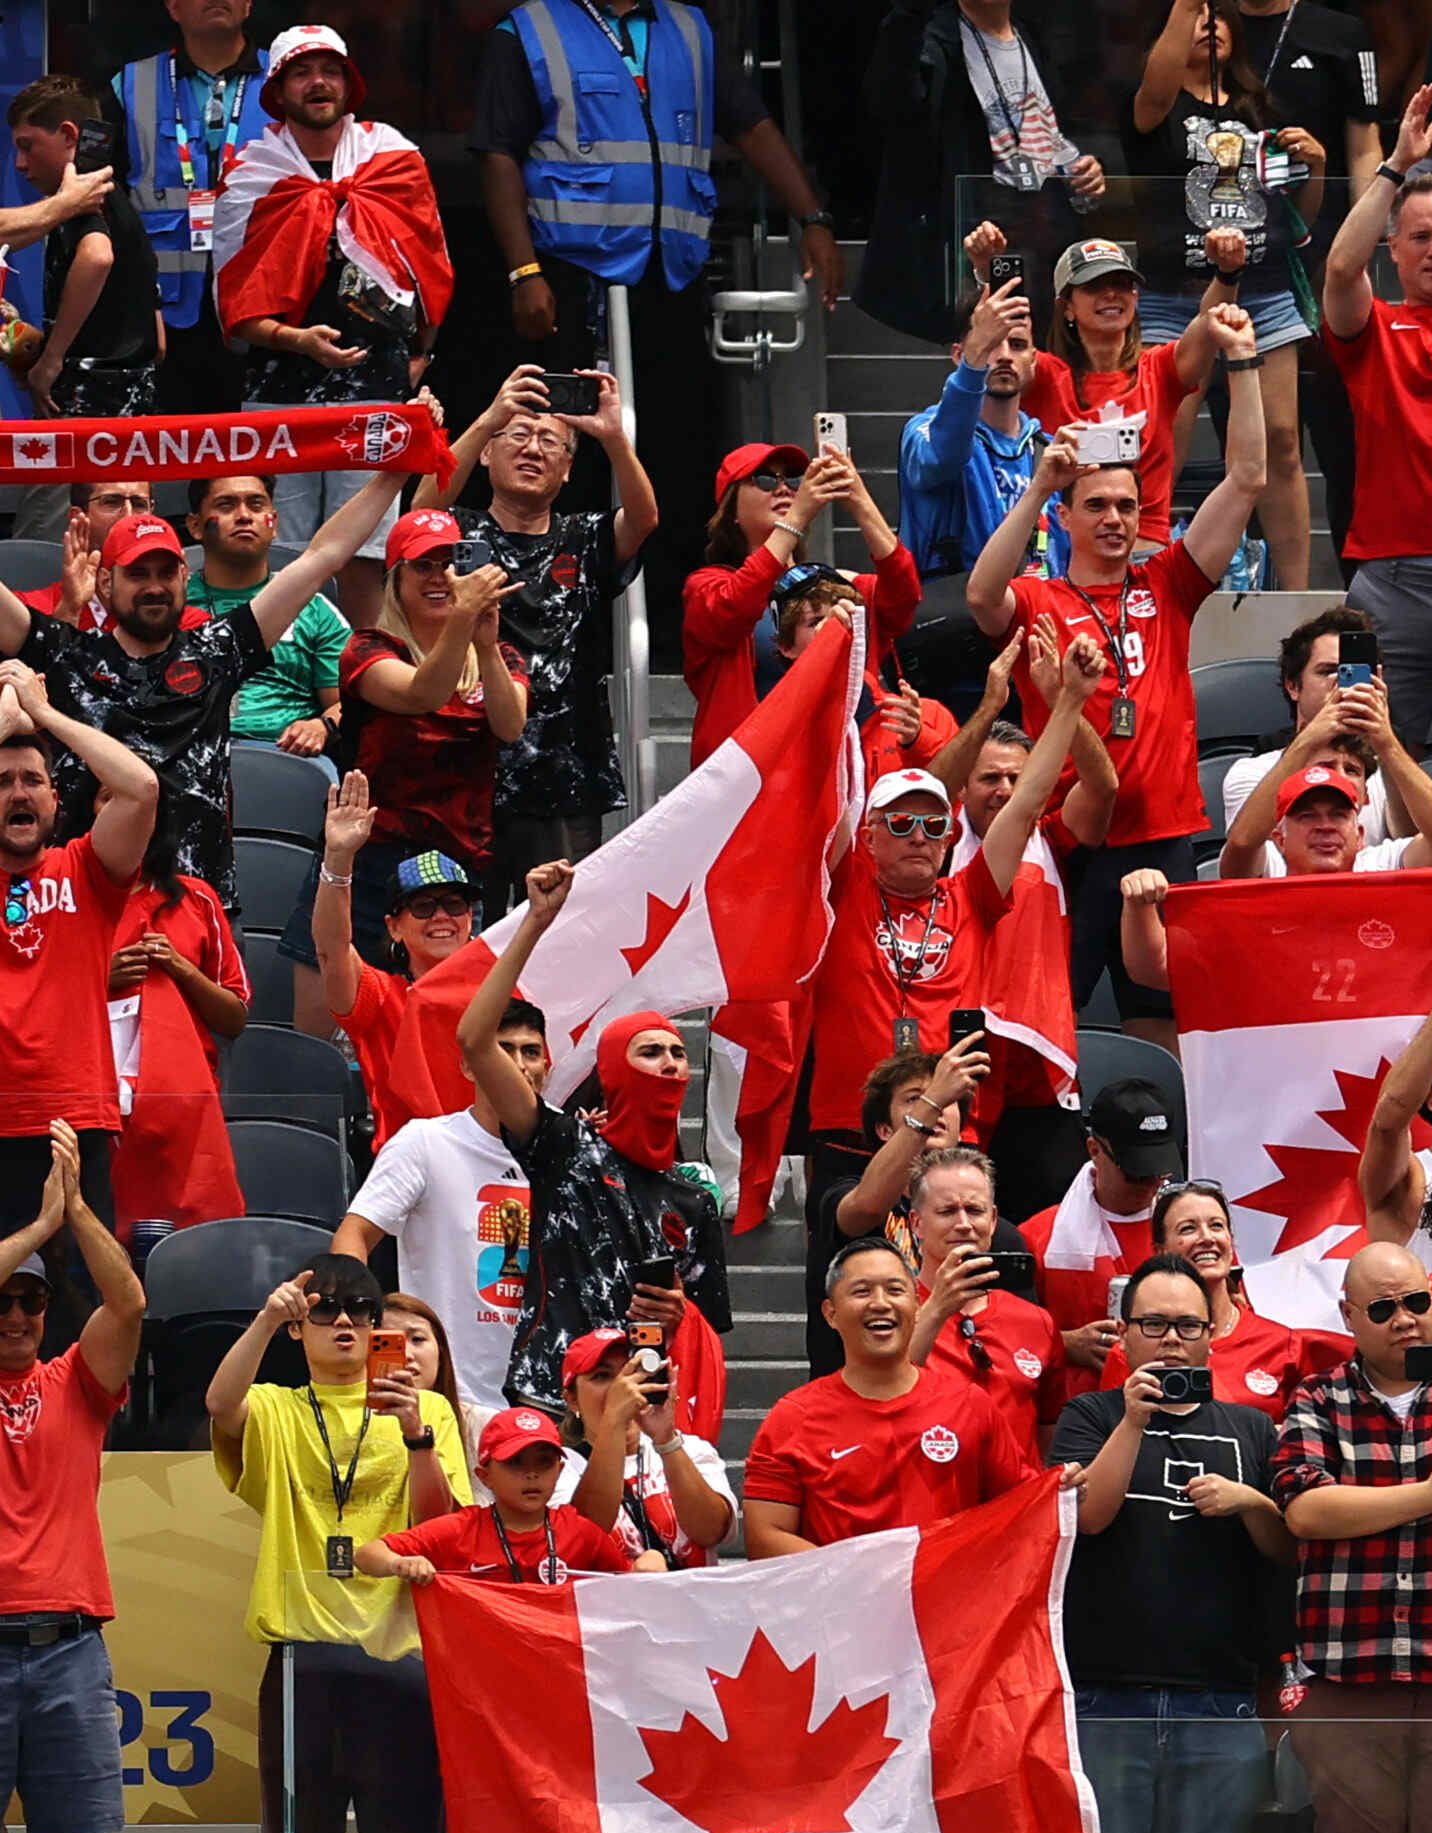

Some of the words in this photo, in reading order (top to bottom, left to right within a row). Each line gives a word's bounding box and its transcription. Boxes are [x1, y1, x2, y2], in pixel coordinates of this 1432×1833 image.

[1210, 204, 1248, 222] FIFA
[87, 423, 298, 467] CANADA
[1311, 958, 1357, 1002] 22
[497, 1282, 524, 1298] FIFA
